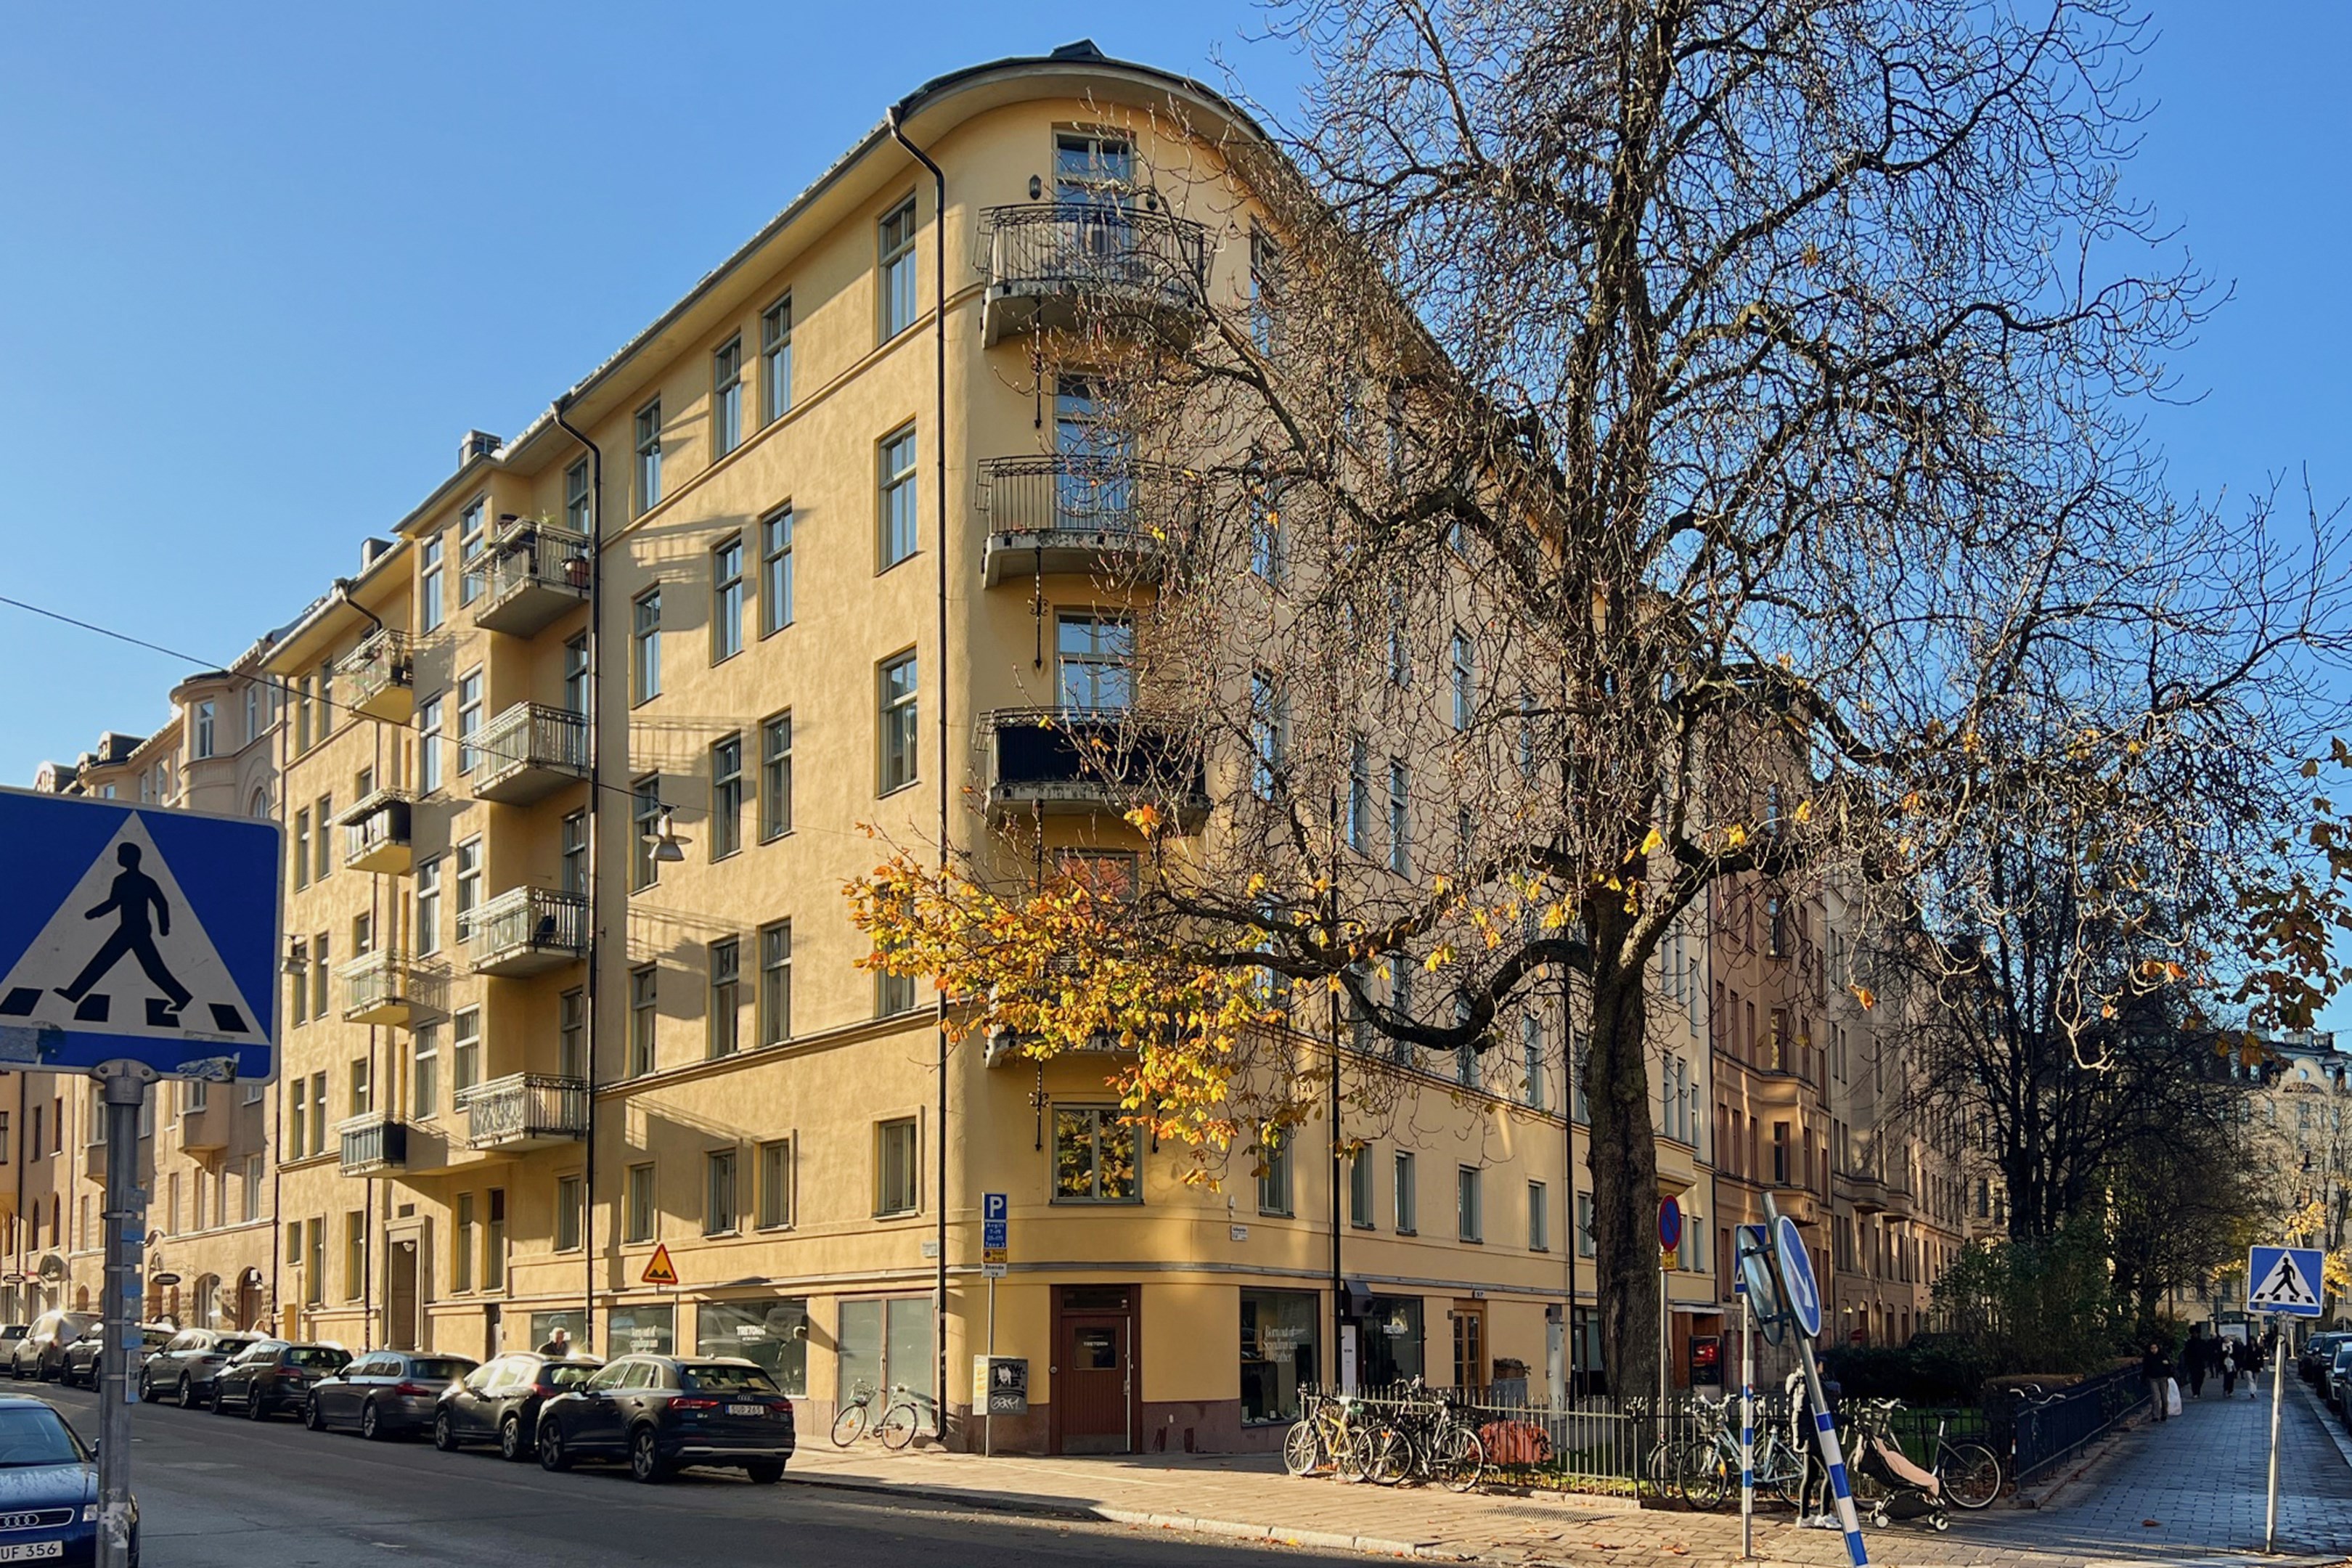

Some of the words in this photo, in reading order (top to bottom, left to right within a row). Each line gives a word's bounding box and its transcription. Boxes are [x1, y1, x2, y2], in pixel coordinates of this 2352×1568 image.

[989, 1196, 1004, 1218] P
[1, 1546, 20, 1560] UF
[26, 1543, 57, 1558] 356
